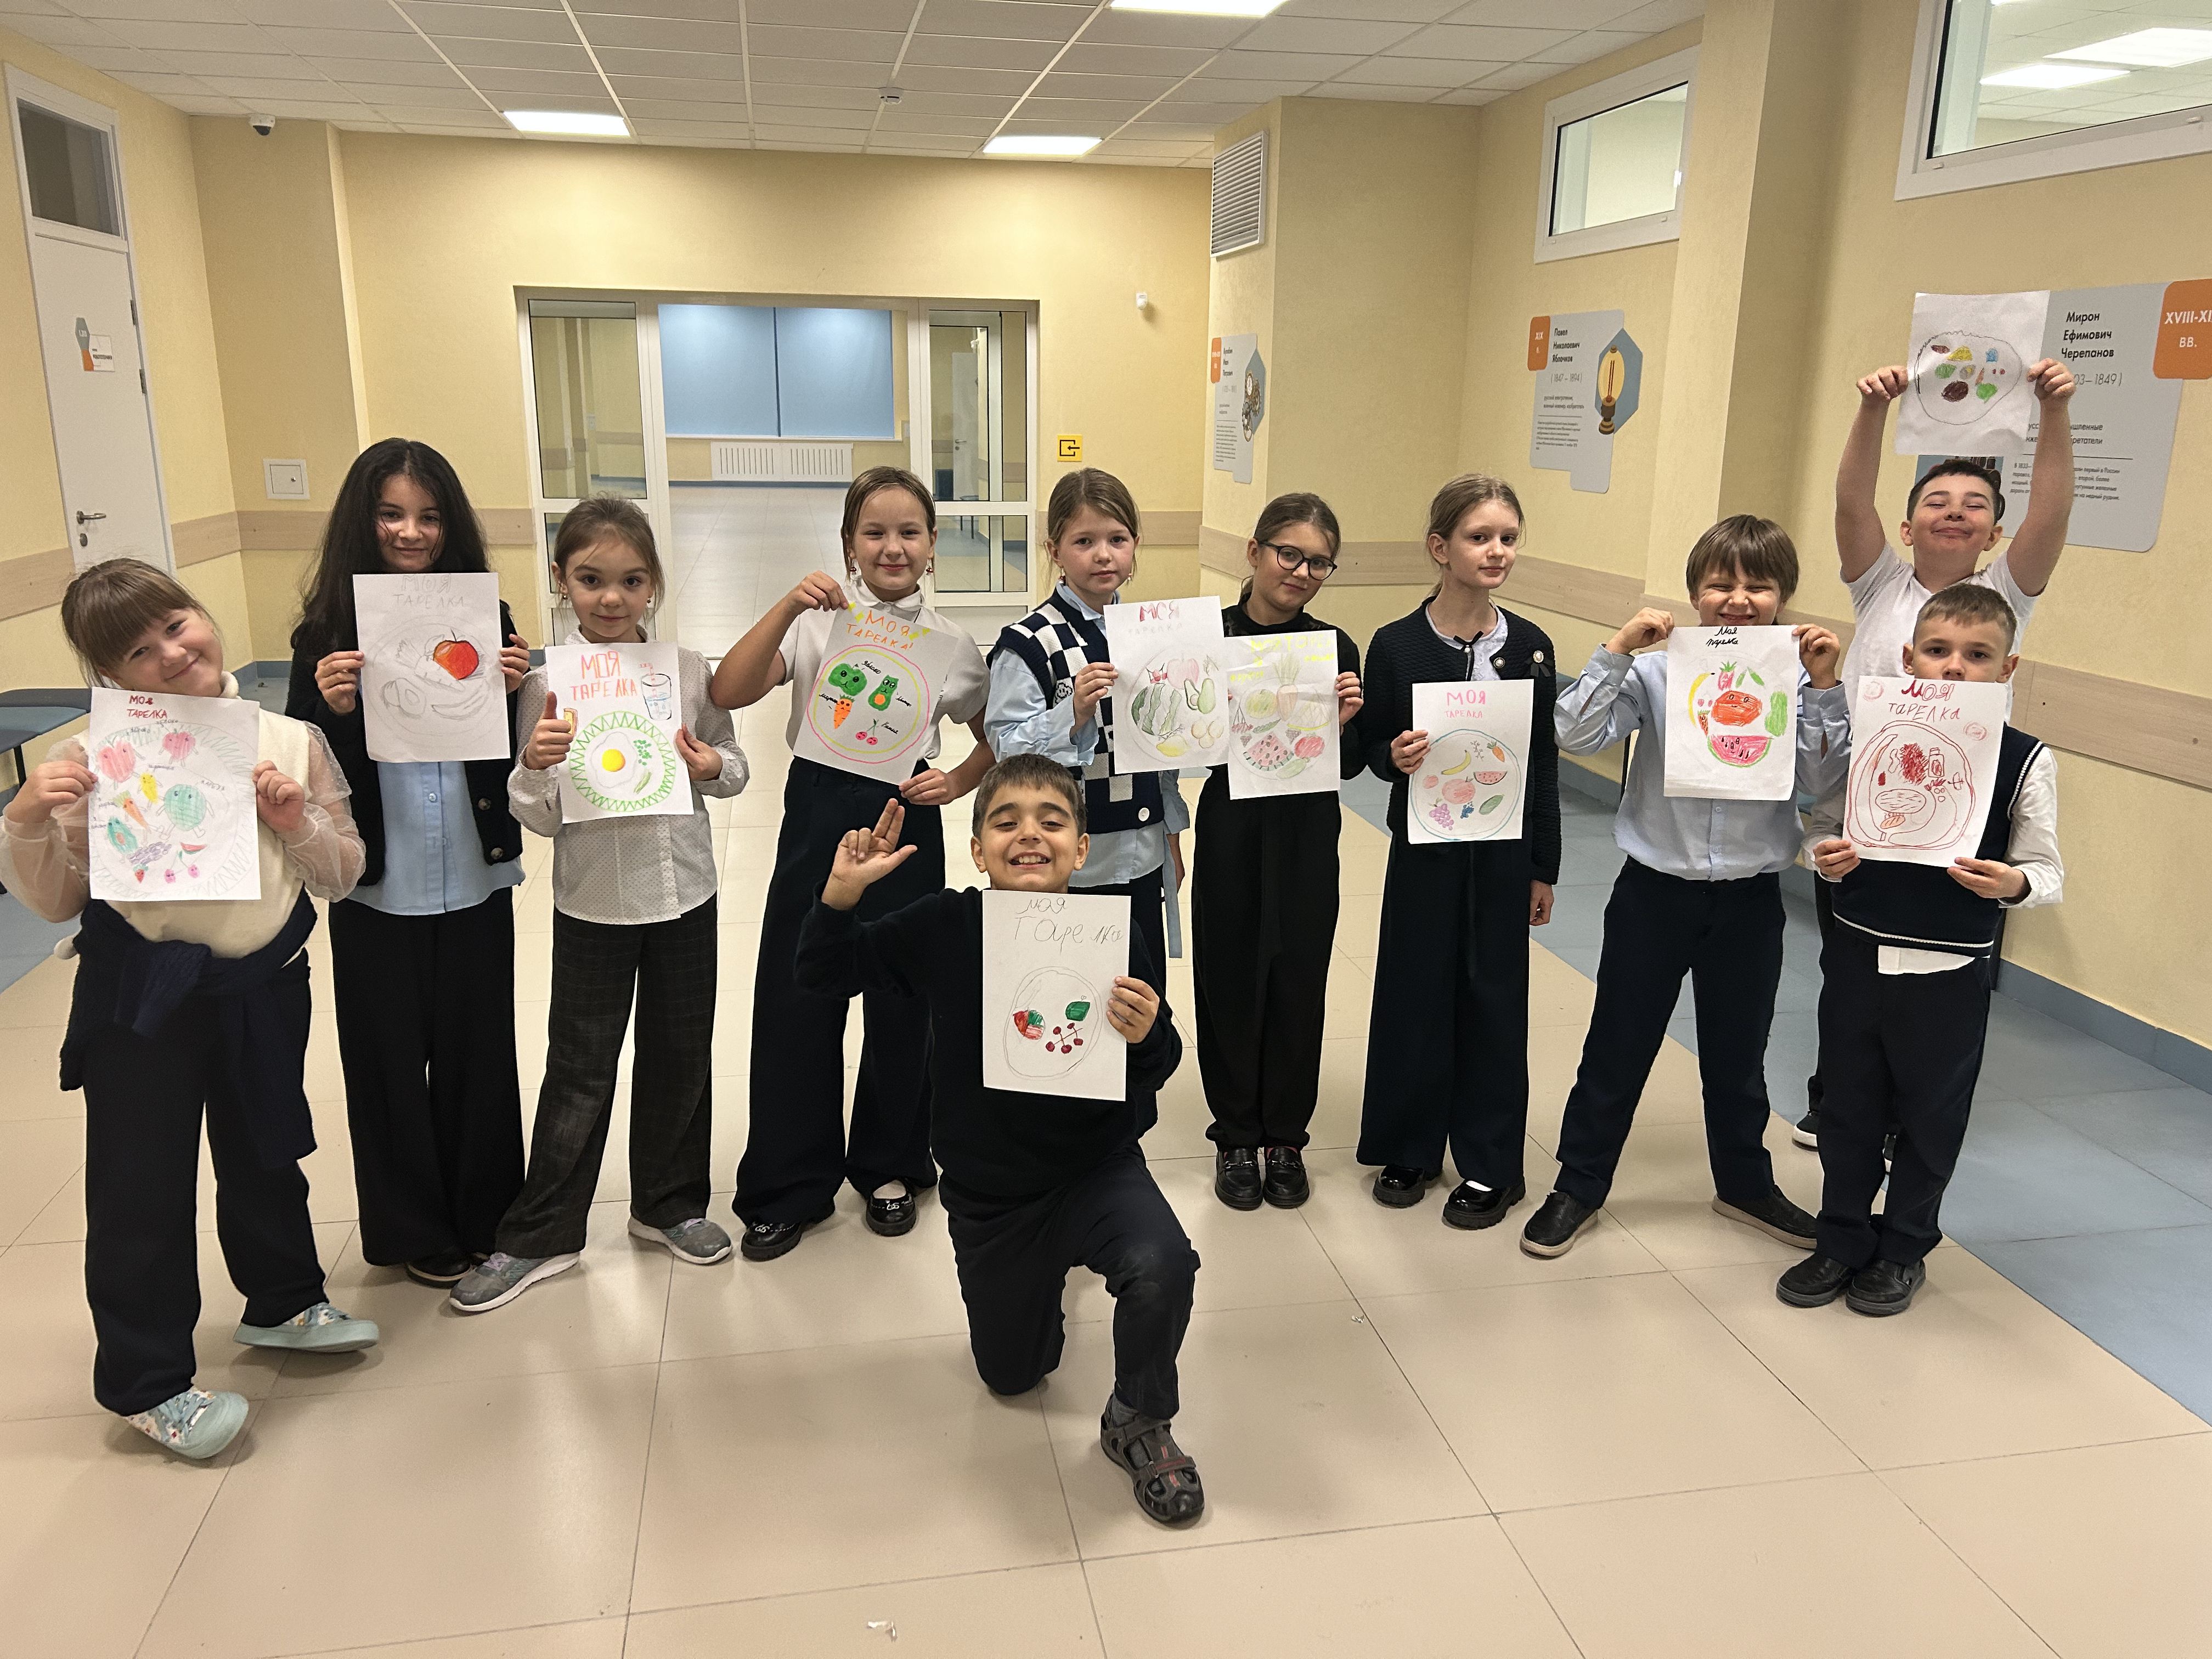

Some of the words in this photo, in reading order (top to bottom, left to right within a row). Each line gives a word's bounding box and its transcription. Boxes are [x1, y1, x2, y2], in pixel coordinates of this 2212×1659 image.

[2066, 311, 2100, 325] Мирон
[2165, 310, 2212, 324] XVIII-XI
[2063, 329, 2112, 343] Ефимович
[2061, 347, 2114, 361] Черепанов
[393, 594, 464, 609] ТАРЕЛКА
[865, 610, 910, 636] МОЯ
[581, 651, 621, 679] МОЯ
[568, 678, 637, 701] ТАРЕЛКА
[1447, 690, 1486, 706] МОЯ
[126, 709, 167, 719] ТАРЕЛКА
[1444, 709, 1482, 719] ТАРЕЛКА
